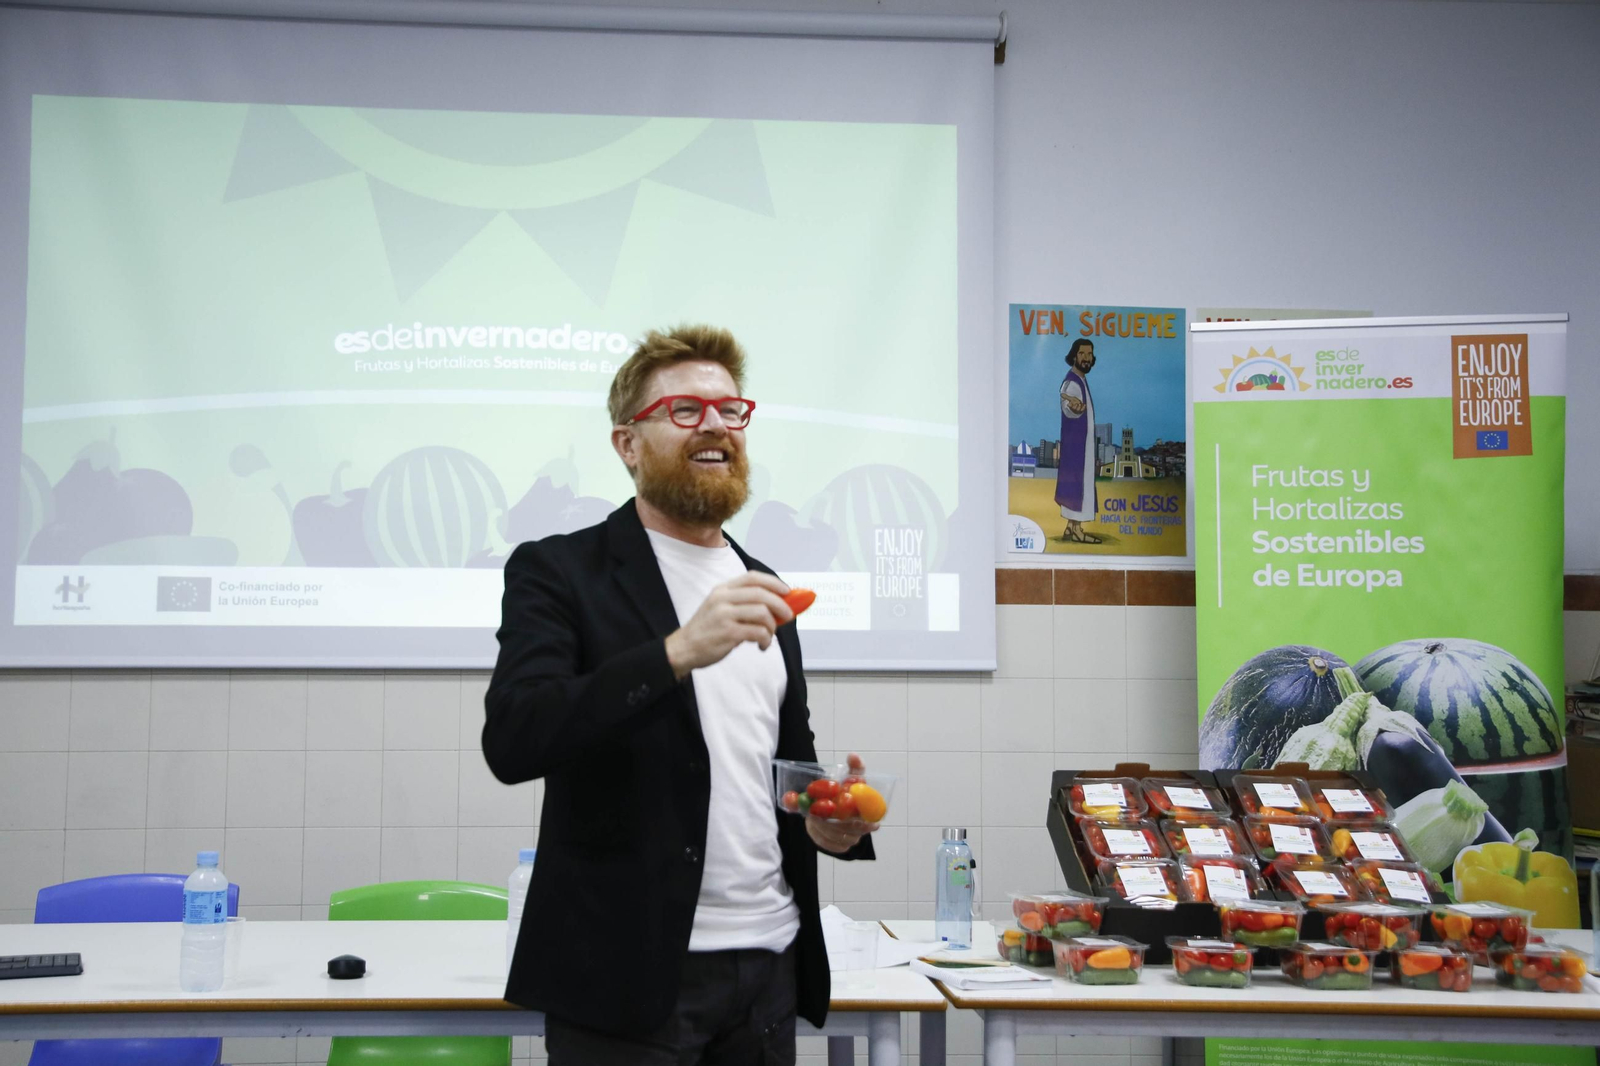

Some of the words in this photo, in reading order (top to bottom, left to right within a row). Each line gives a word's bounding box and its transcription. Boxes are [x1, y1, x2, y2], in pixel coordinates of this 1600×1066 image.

[1019, 309, 1069, 337] VEN,
[334, 322, 635, 355] esdeinvernadero.
[1315, 346, 1360, 361] esde
[1457, 343, 1522, 376] ENJOY
[354, 360, 401, 373] Frutas
[404, 359, 414, 373] y
[416, 355, 491, 370] Hortalizas
[493, 355, 577, 371] Sostenibles
[579, 359, 598, 372] de
[1315, 361, 1365, 376] inver
[1315, 376, 1414, 390] nadero.es
[1460, 377, 1484, 399] IT'S
[1487, 376, 1521, 399] FROM
[1459, 399, 1523, 426] EUROPE
[1251, 464, 1344, 488] Frutas
[1351, 468, 1371, 493] y
[1104, 498, 1126, 512] CON
[1252, 496, 1404, 521] Hortalizas
[1123, 514, 1137, 523] LAS
[1119, 524, 1134, 535] DEL
[1137, 526, 1163, 536] MUNDO
[875, 528, 924, 556] ENJOY
[1252, 529, 1425, 554] Sostenibles
[876, 556, 895, 575] IT'S
[896, 556, 922, 575] FROM
[218, 581, 301, 592] Co-financiado
[304, 583, 323, 594] por
[875, 575, 923, 598] EUROPE
[1252, 563, 1290, 587] de
[1297, 563, 1403, 593] Europa
[218, 596, 228, 606] la
[232, 596, 267, 606] Unión
[270, 596, 319, 608] Europea
[815, 595, 855, 604] UALITY
[805, 607, 855, 618] RODUCTS.
